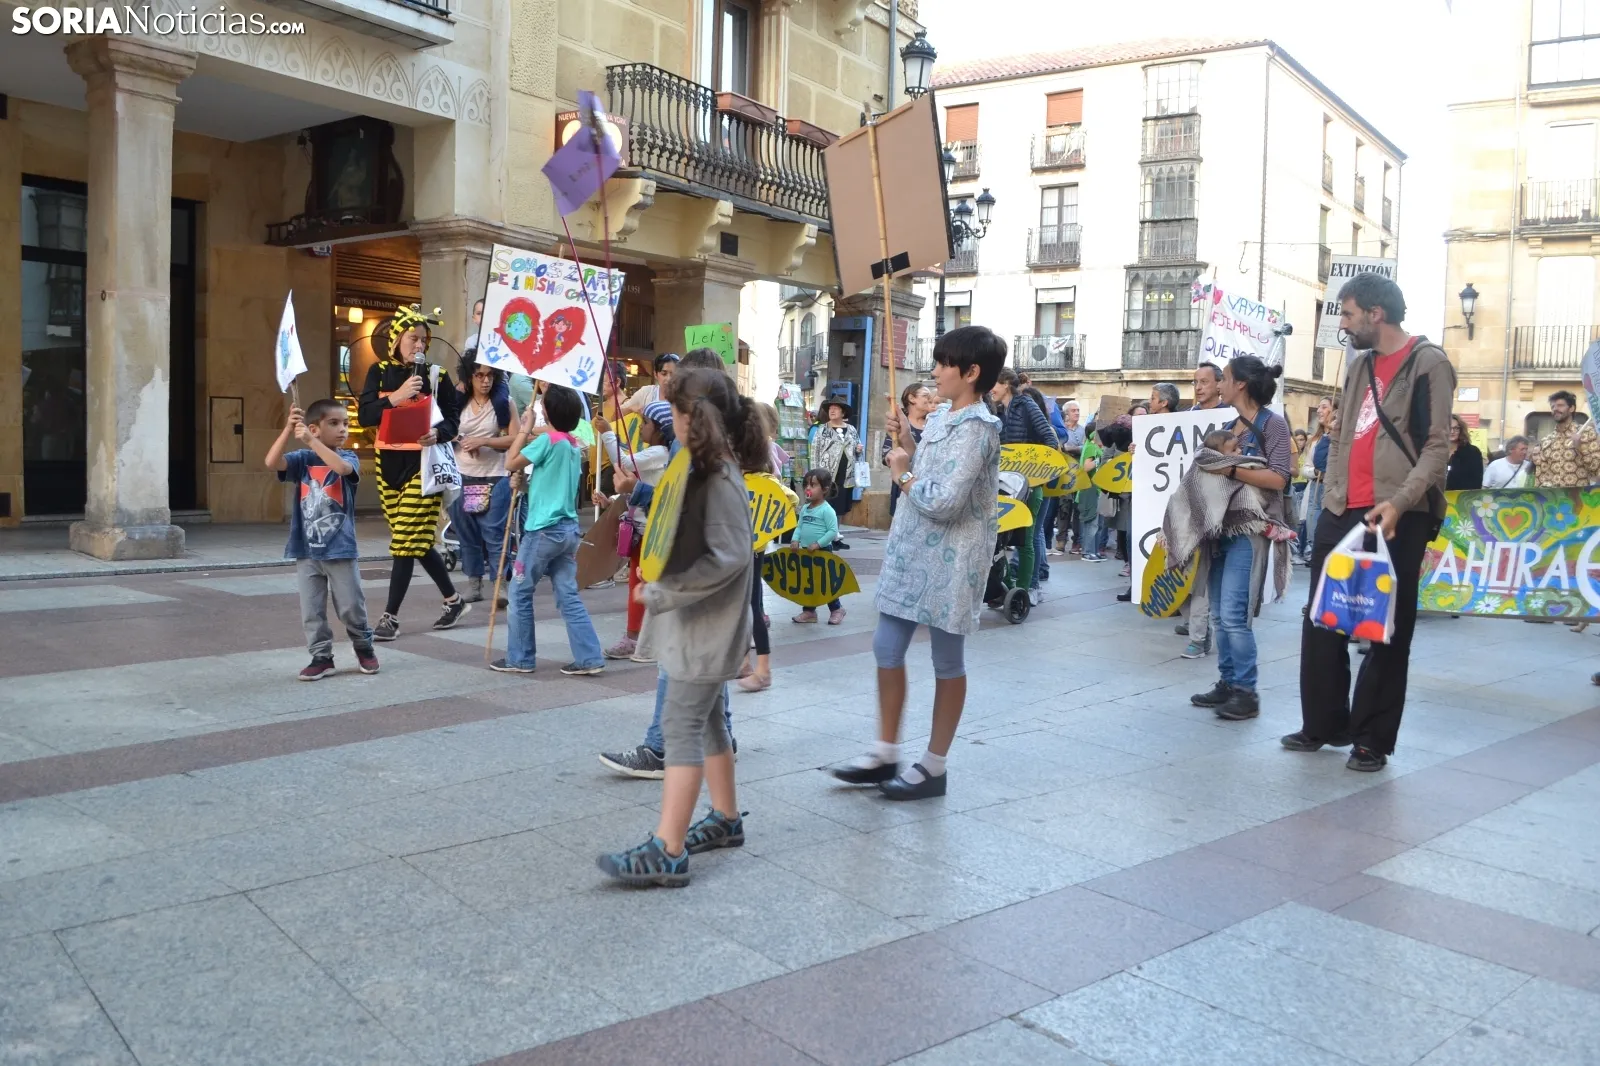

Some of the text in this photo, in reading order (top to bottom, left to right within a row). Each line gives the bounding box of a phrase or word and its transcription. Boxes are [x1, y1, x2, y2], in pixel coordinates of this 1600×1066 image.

[558, 111, 577, 121] NUEVA
[494, 249, 564, 278] SOMOS
[488, 271, 509, 286] DE
[524, 275, 564, 296] MISMO
[343, 297, 397, 309] ESPECIALIDADES
[1227, 294, 1266, 321] VAYA
[1211, 311, 1270, 344] EJEMPLO
[1205, 336, 1230, 359] QUE
[763, 552, 846, 597] ALEGRE
[1429, 540, 1571, 589] AHORA
